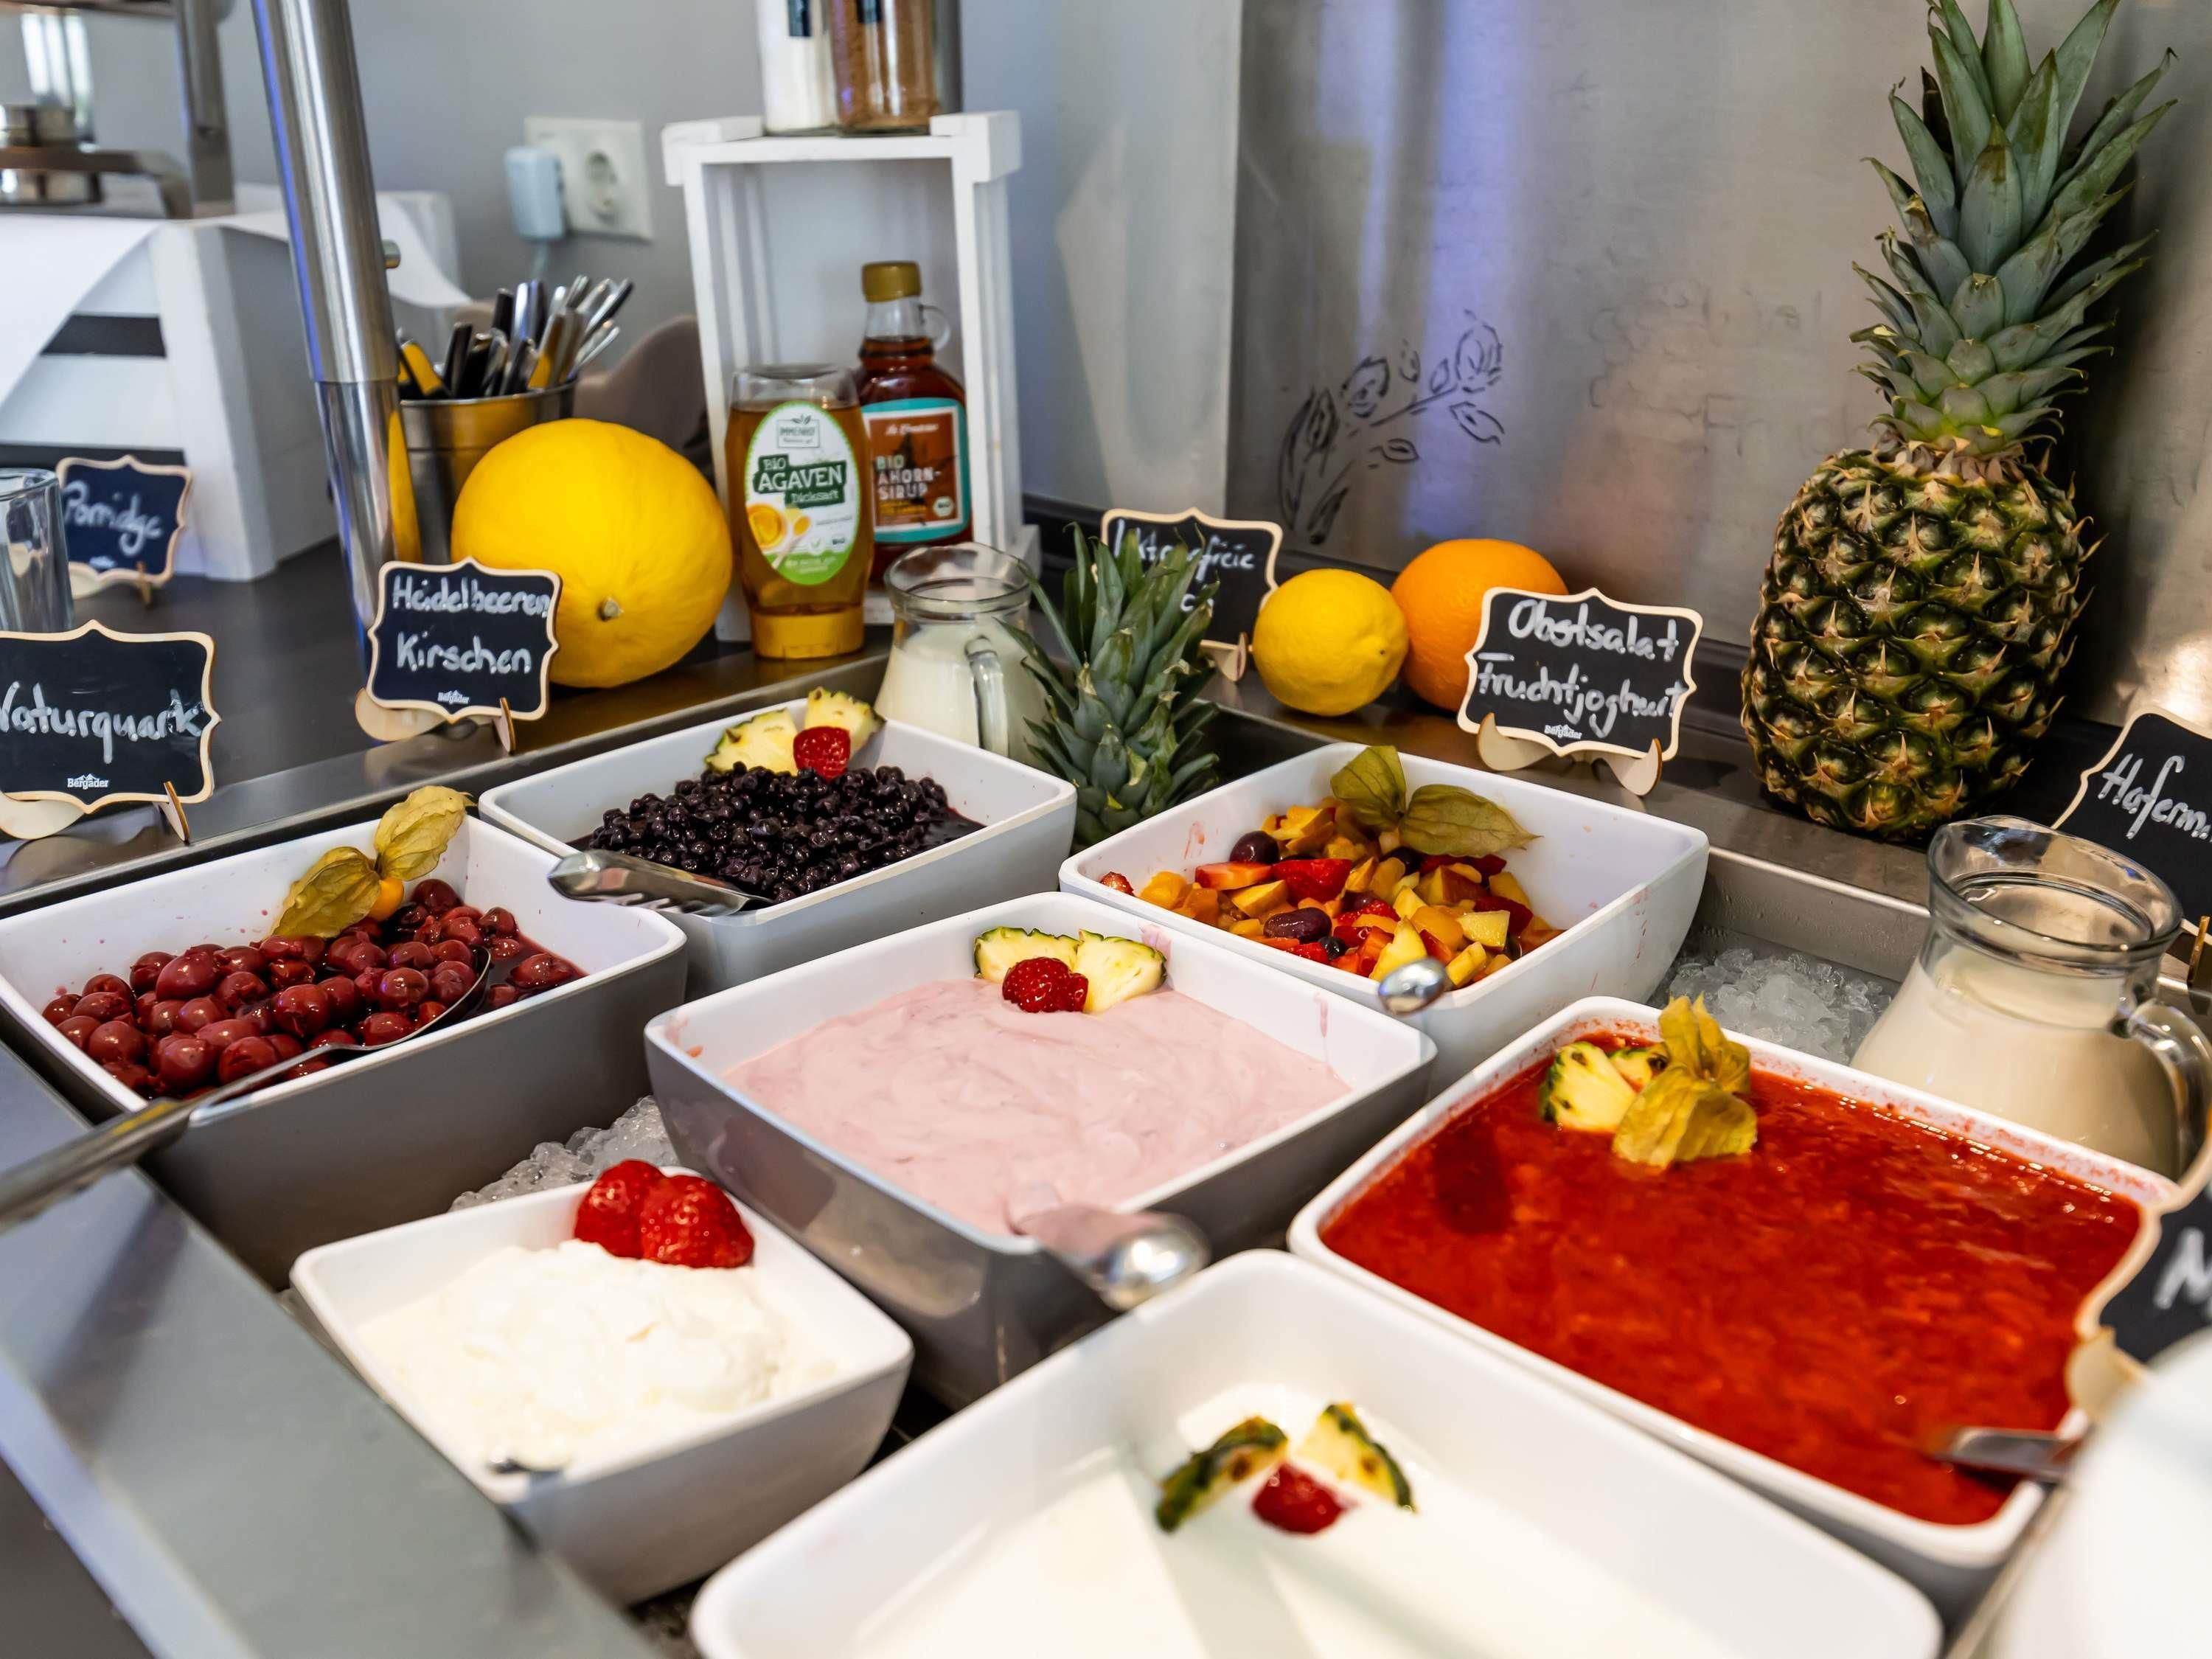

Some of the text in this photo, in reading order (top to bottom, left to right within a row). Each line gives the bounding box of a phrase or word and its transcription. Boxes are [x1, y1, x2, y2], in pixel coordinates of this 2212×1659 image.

[757, 465, 842, 491] AGAVEN
[876, 455, 904, 470] BIO
[878, 467, 942, 486] AHORN-
[877, 483, 928, 500] SIRUP
[63, 479, 162, 557] Porridge
[392, 574, 552, 618] Heidelbeeren
[1508, 599, 1679, 661] Obstsalat
[397, 631, 532, 674] Kirschen
[1478, 652, 1689, 738] Fruchtjoghurt
[67, 776, 109, 789] Bergader
